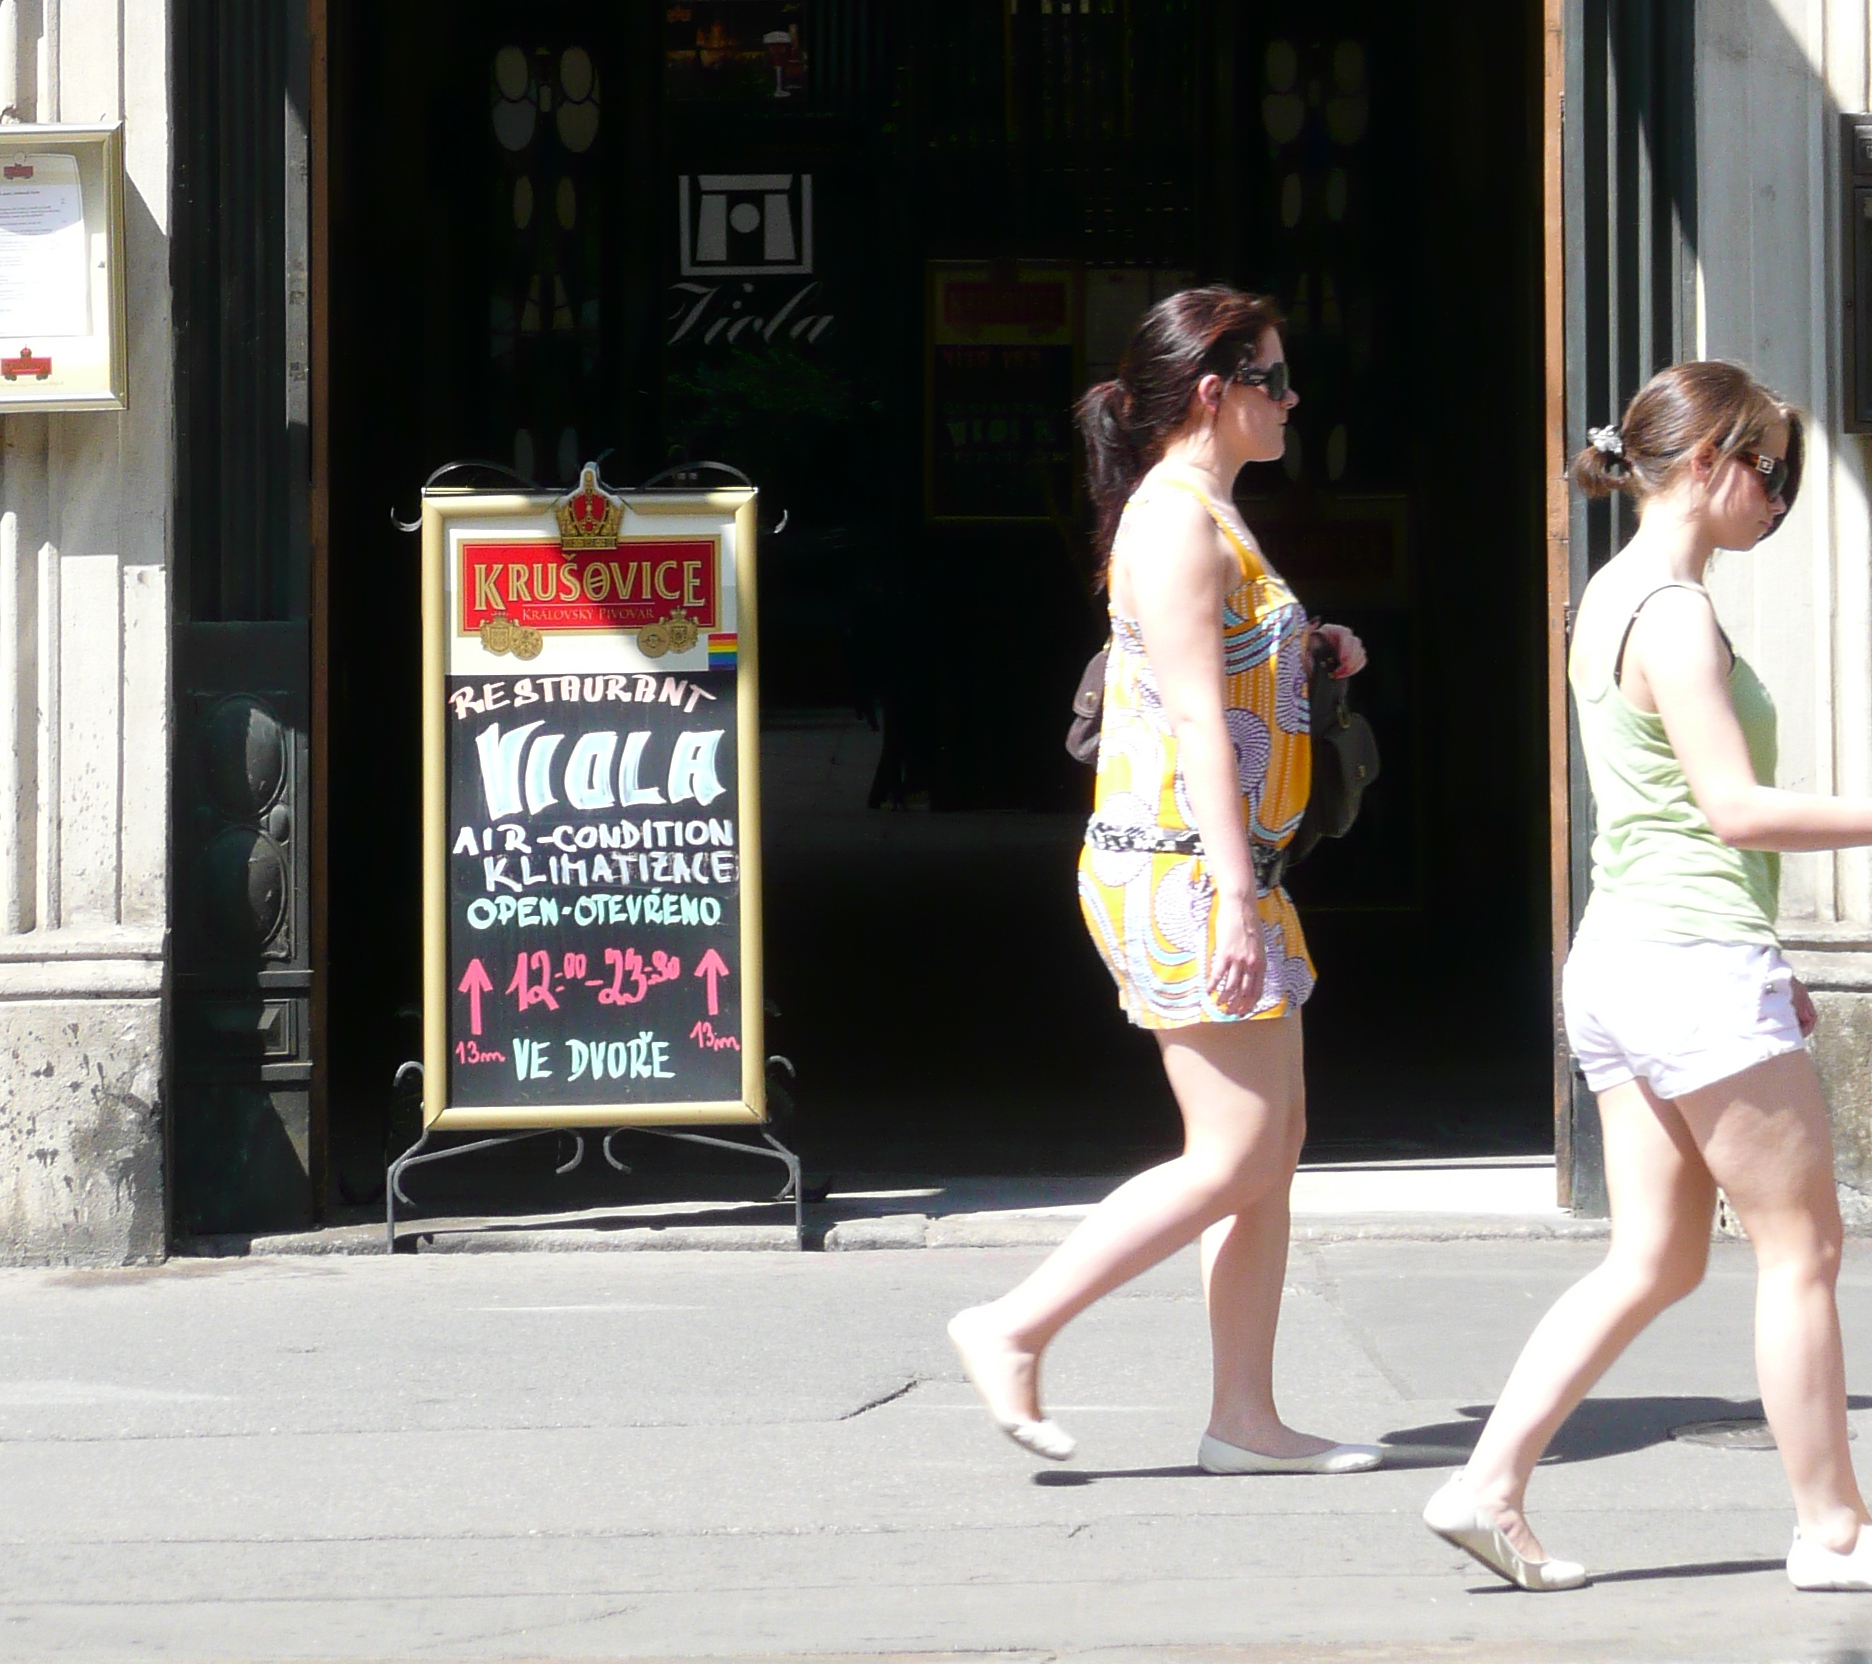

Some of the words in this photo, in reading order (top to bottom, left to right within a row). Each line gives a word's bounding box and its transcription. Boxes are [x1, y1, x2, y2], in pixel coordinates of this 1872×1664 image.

[667, 281, 835, 347] Viola
[473, 553, 706, 612] KRUŠOVICE
[448, 674, 717, 720] RESTAURANT
[475, 720, 727, 822] VIOLA
[483, 850, 737, 892] KLIMATIZACE
[512, 1038, 553, 1081] VE
[565, 1031, 676, 1081] DVOŘE
